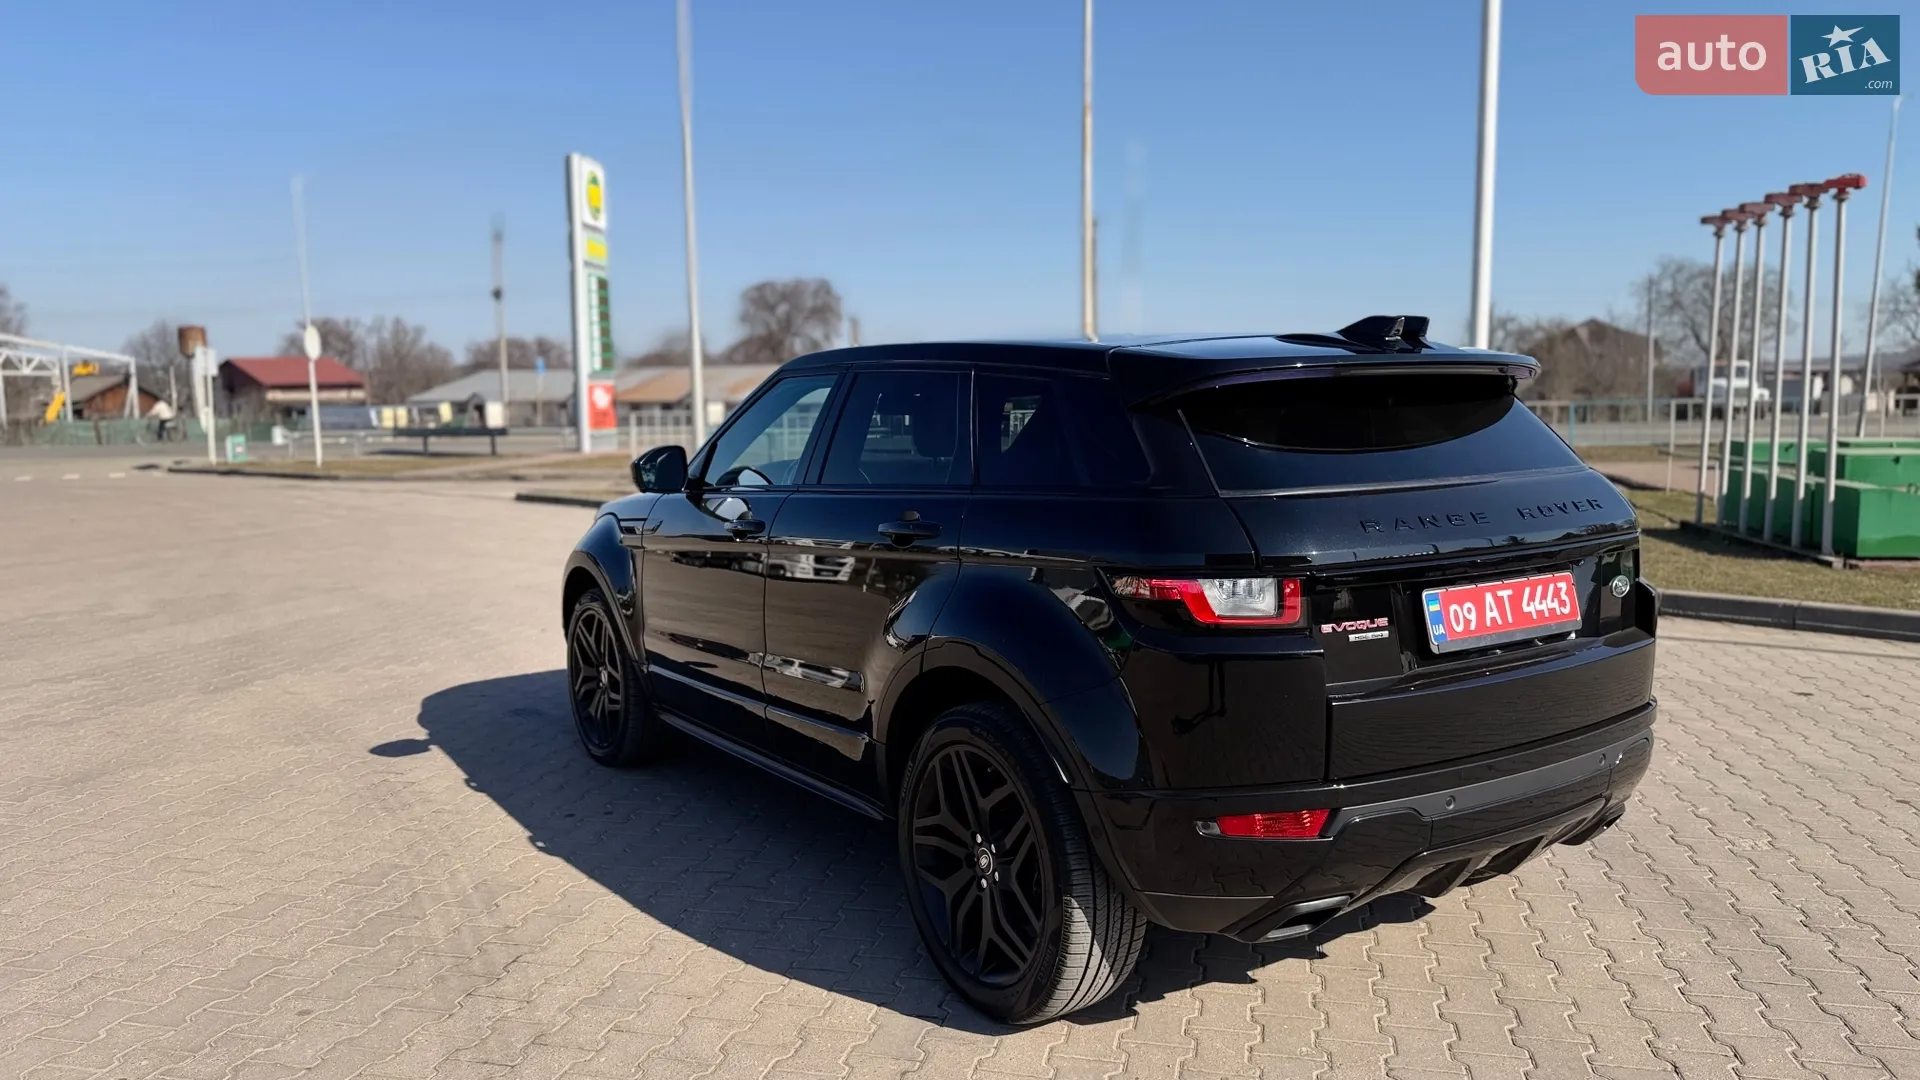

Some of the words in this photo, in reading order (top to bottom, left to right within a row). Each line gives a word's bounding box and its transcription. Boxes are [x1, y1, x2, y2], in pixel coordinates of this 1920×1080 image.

[1359, 511, 1491, 534] RANGE
[1516, 498, 1604, 520] ROVER
[1449, 601, 1477, 633] 09
[1484, 588, 1513, 628] AT
[1521, 581, 1571, 620] 4443
[1320, 617, 1389, 634] EVOQUE
[1432, 624, 1446, 636] UA
